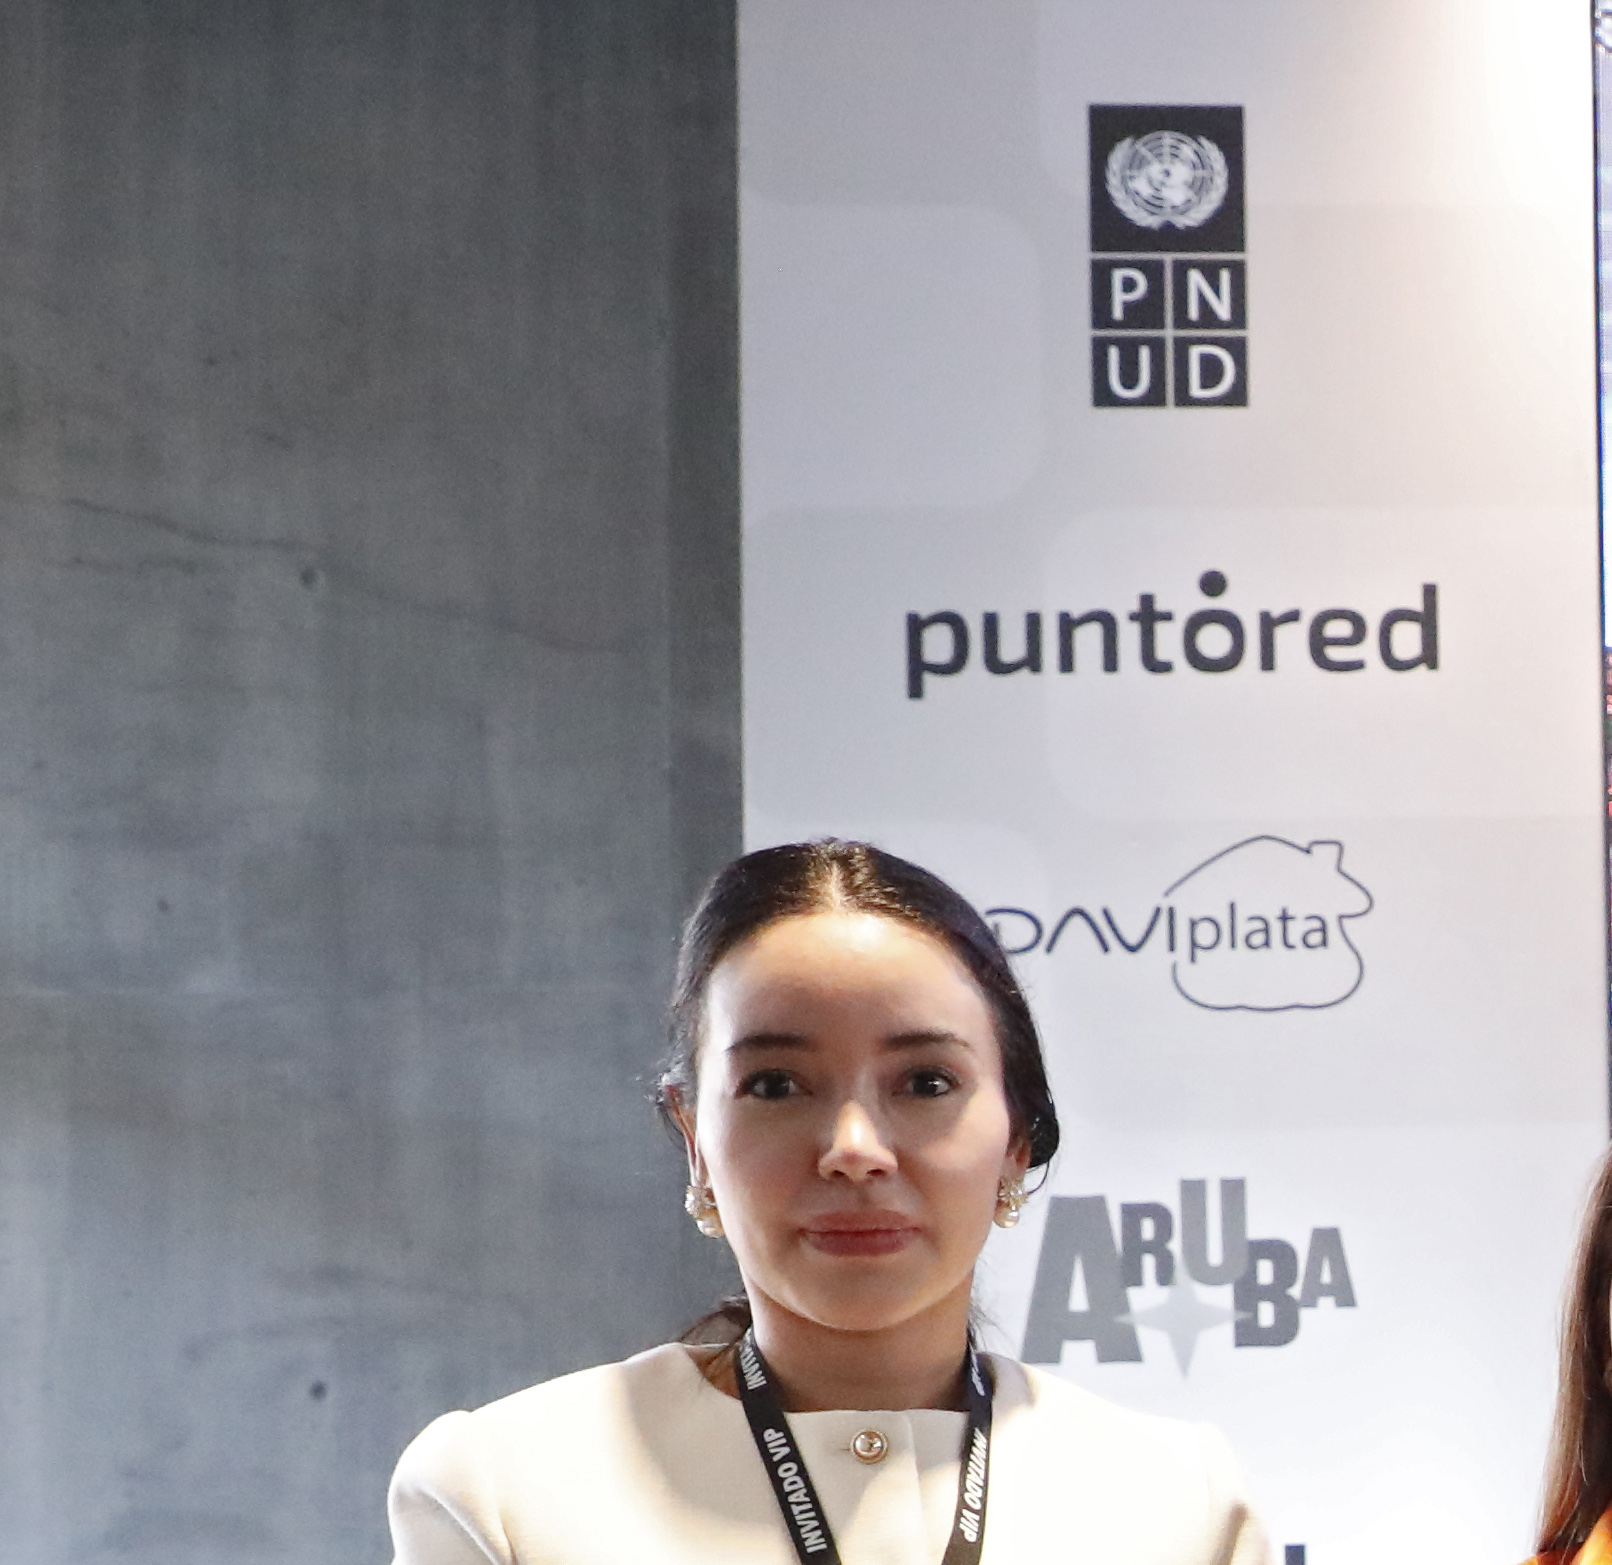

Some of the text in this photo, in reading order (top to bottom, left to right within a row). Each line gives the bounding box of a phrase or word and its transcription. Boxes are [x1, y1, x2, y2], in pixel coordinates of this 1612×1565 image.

[1020, 1177, 1357, 1364] ARUBA
[763, 1427, 827, 1554] INVITADO VIP
[963, 1427, 987, 1543] INVITADO VIP
